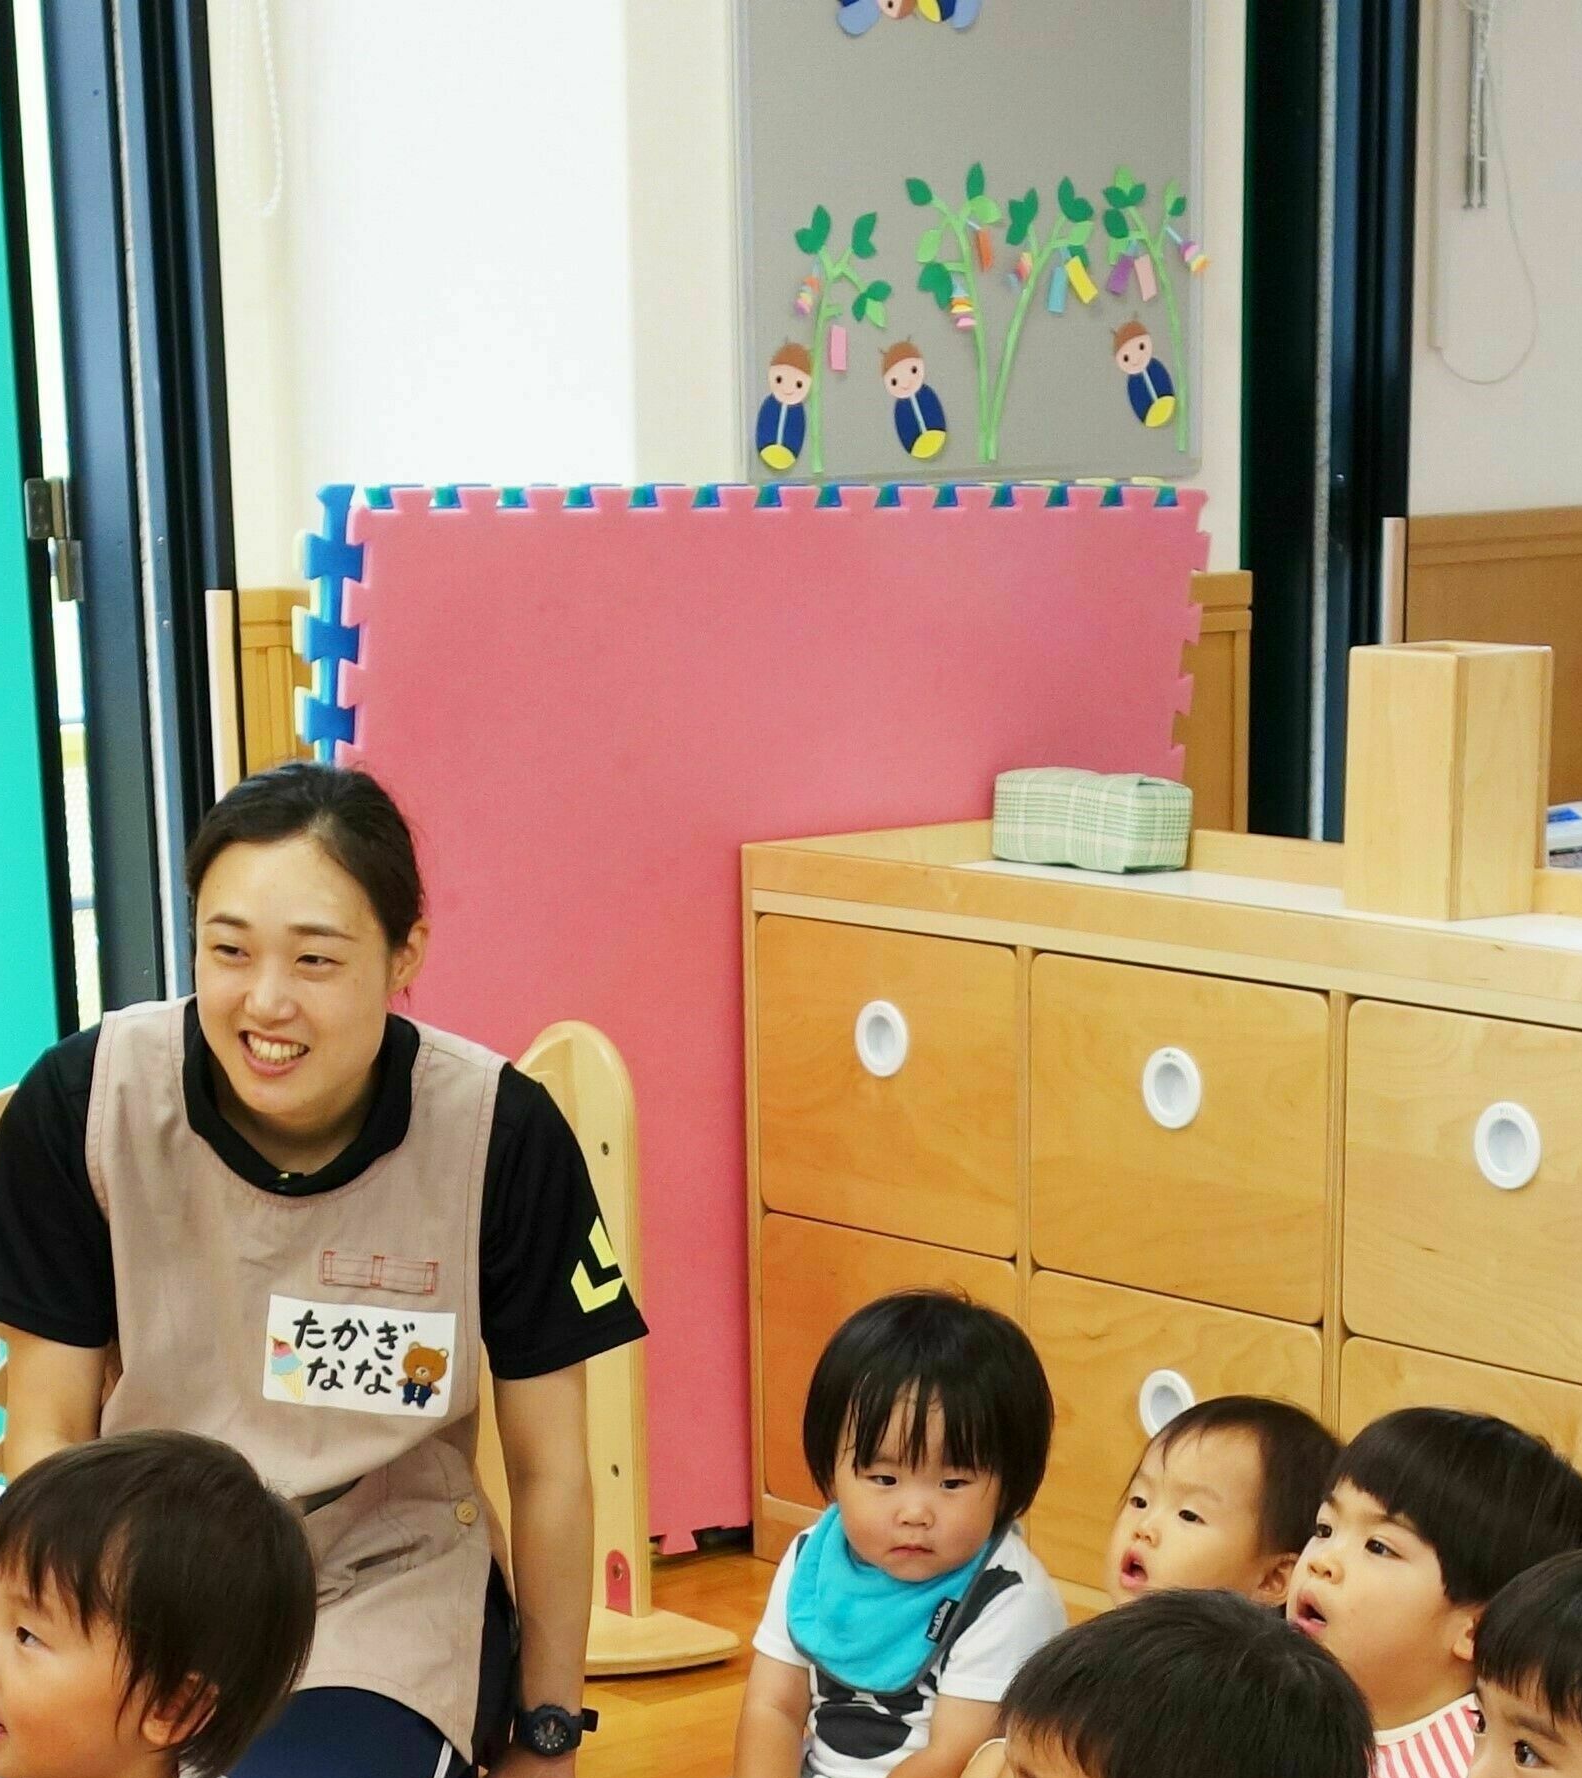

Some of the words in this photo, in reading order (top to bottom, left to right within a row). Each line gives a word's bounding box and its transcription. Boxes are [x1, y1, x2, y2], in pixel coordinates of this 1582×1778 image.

[292, 1309, 417, 1361] たかぎ
[306, 1357, 393, 1396] なな
